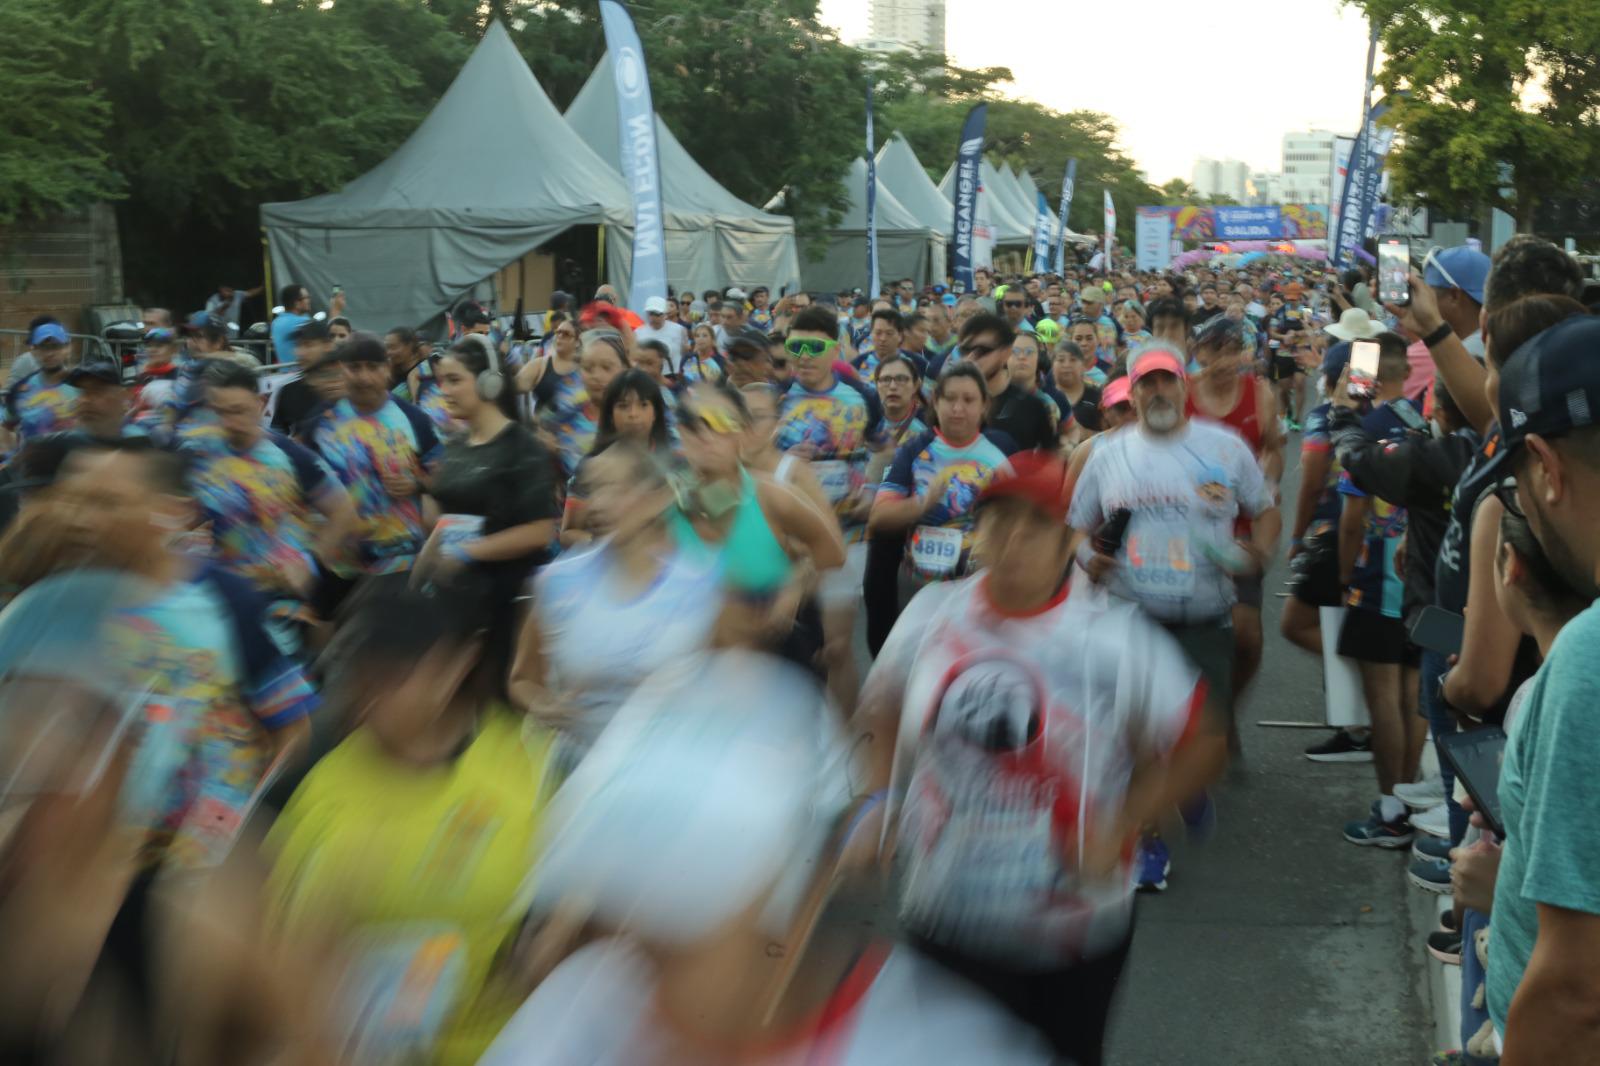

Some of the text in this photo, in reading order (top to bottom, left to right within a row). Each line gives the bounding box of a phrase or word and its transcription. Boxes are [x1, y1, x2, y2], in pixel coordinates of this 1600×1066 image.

[956, 159, 974, 259] ARCANGEL
[1224, 225, 1270, 236] SALIDA
[914, 538, 956, 557] 4819
